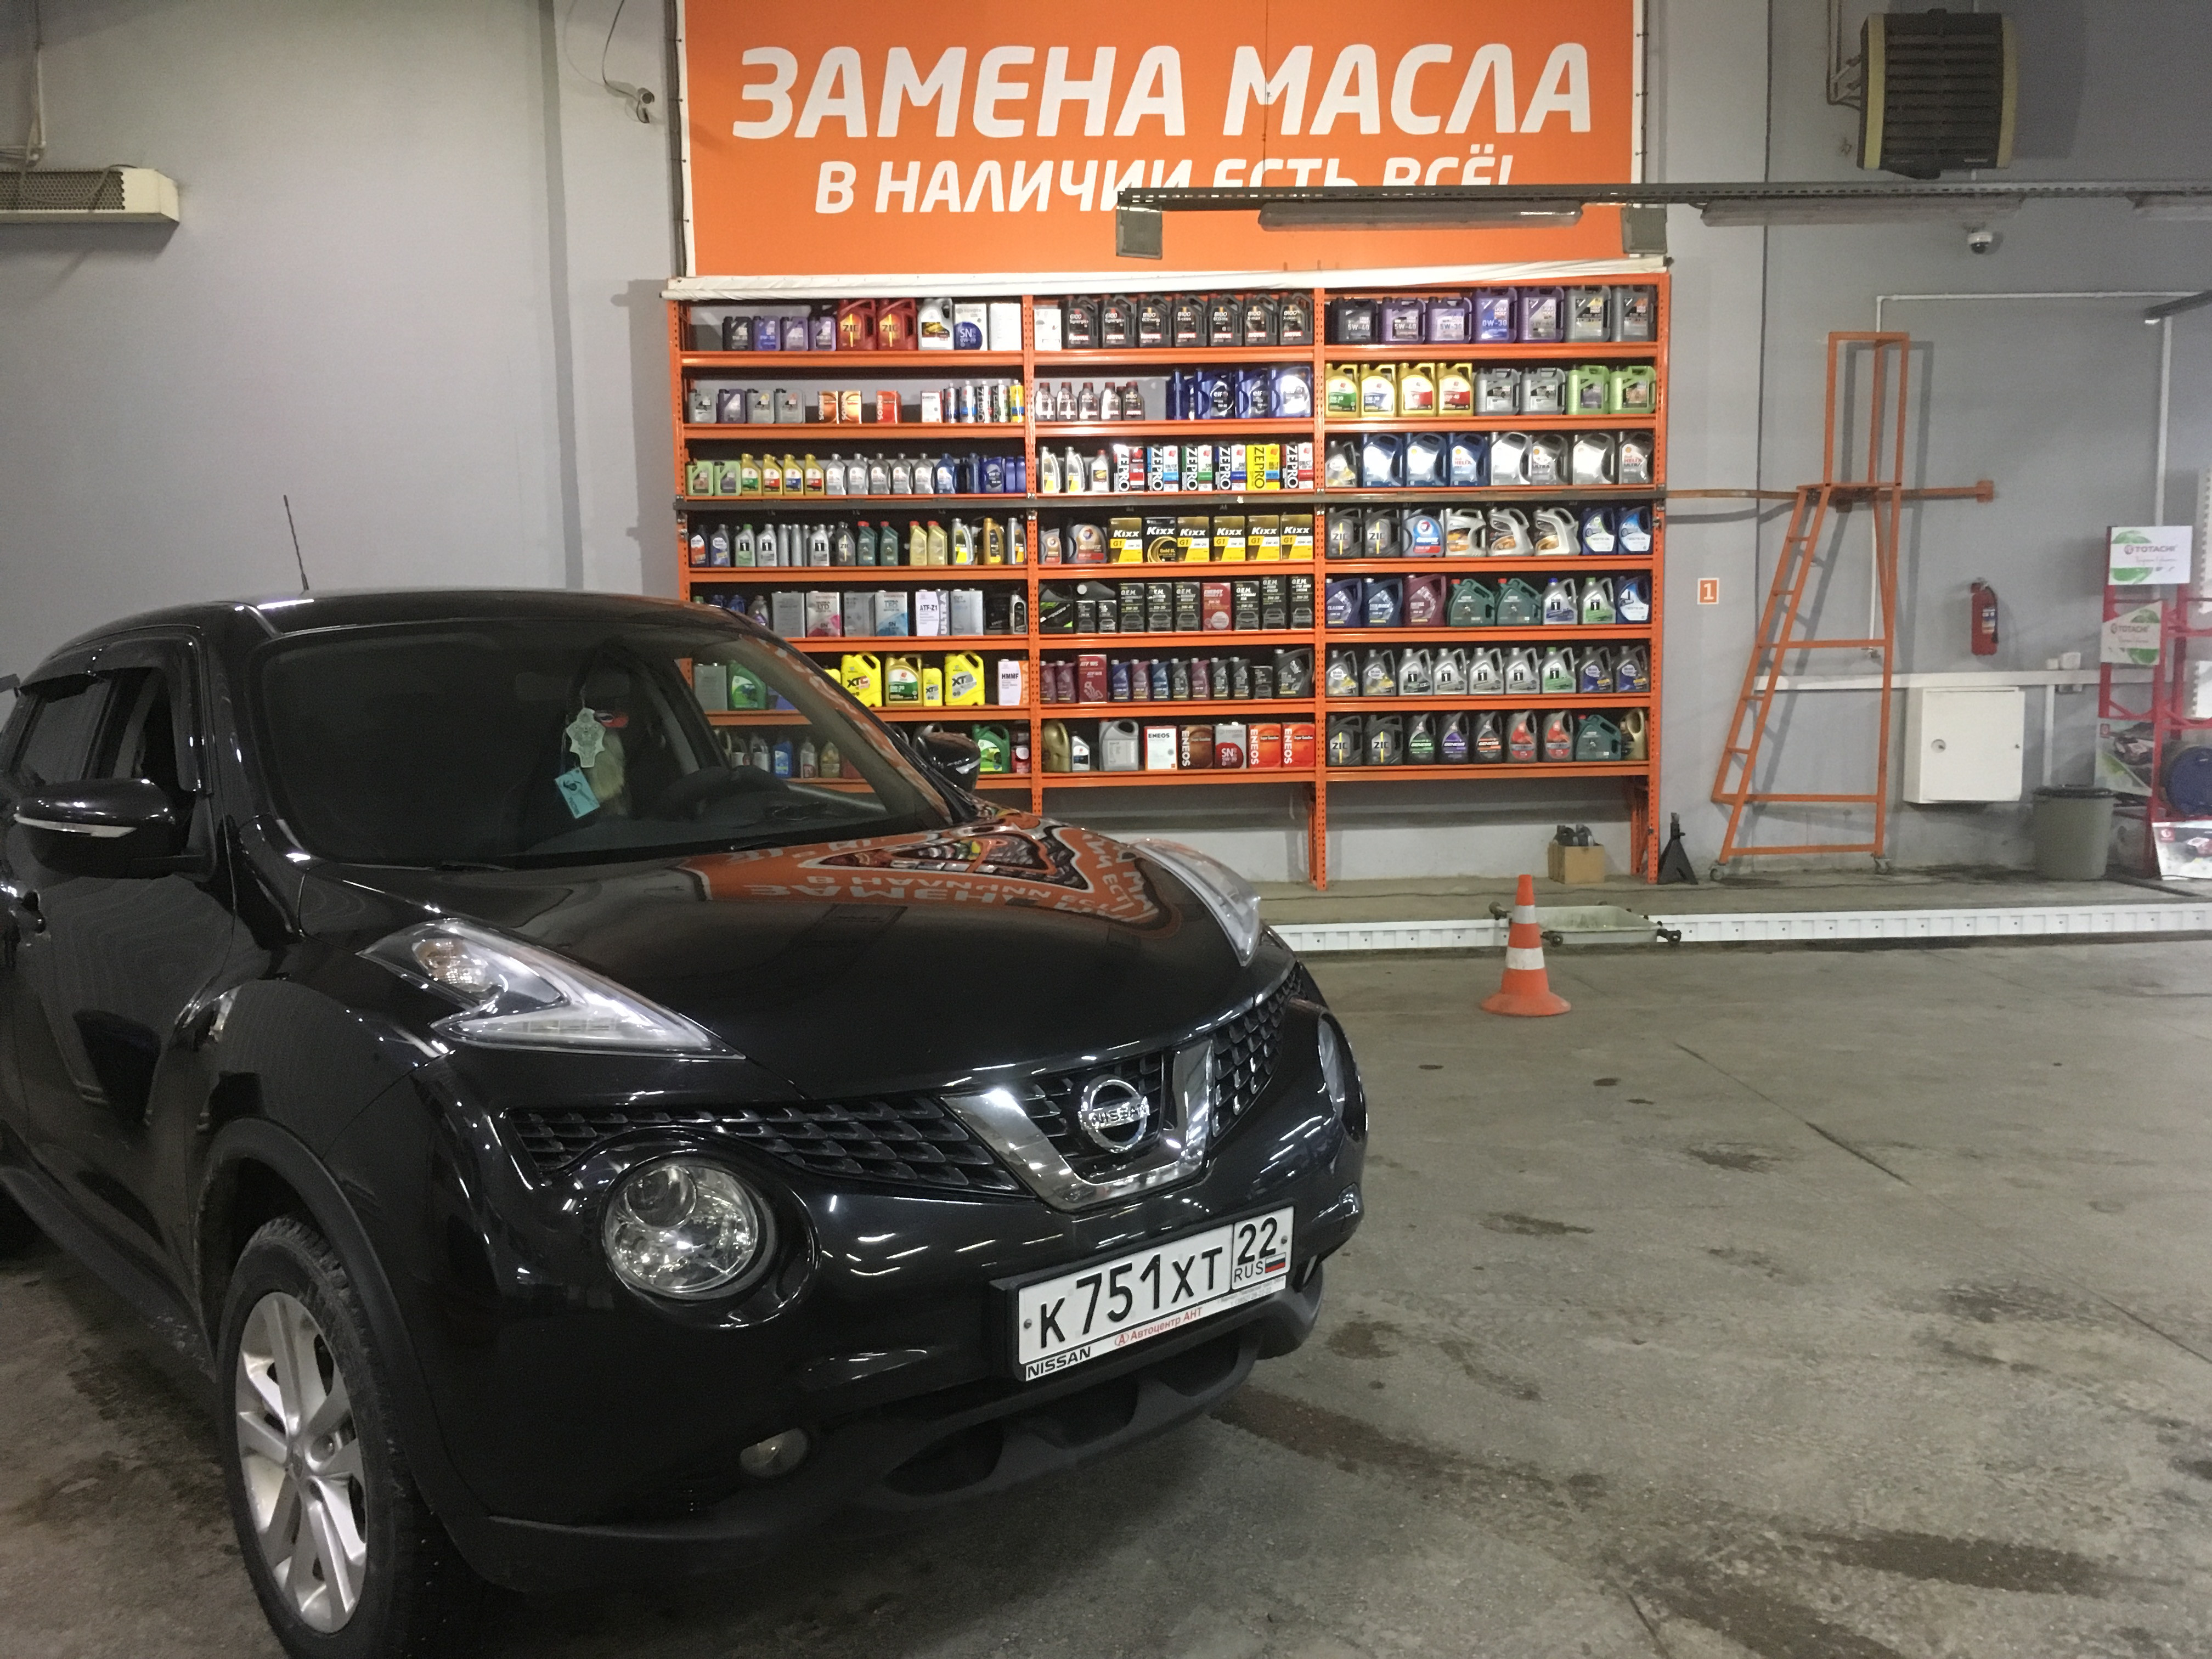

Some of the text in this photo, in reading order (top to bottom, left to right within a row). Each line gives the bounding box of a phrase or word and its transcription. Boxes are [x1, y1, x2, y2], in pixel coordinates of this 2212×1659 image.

[732, 43, 1590, 139] ЗАМЕНА МАСЛА
[815, 161, 856, 213] В
[875, 159, 1193, 213] НАЛИЧИИ
[1152, 447, 1163, 491] ZEPRO
[1187, 447, 1198, 490] ZEPRO
[1220, 447, 1231, 490] ZEPRO
[1254, 447, 1265, 489] ZEPRO
[1286, 445, 1299, 488] ZEPRO
[1147, 527, 1175, 535] Kixx
[1703, 583, 1713, 600] 1
[1181, 730, 1190, 766] ENEOS
[1221, 748, 1234, 757] SN
[1250, 729, 1259, 765] ENEOS
[1238, 1217, 1278, 1265] 22
[1233, 1261, 1263, 1283] RUS
[1040, 1247, 1222, 1348] К751ХТ
[1130, 1307, 1203, 1341] Автоцентр АНТ
[1027, 1346, 1091, 1379] NISSAN
